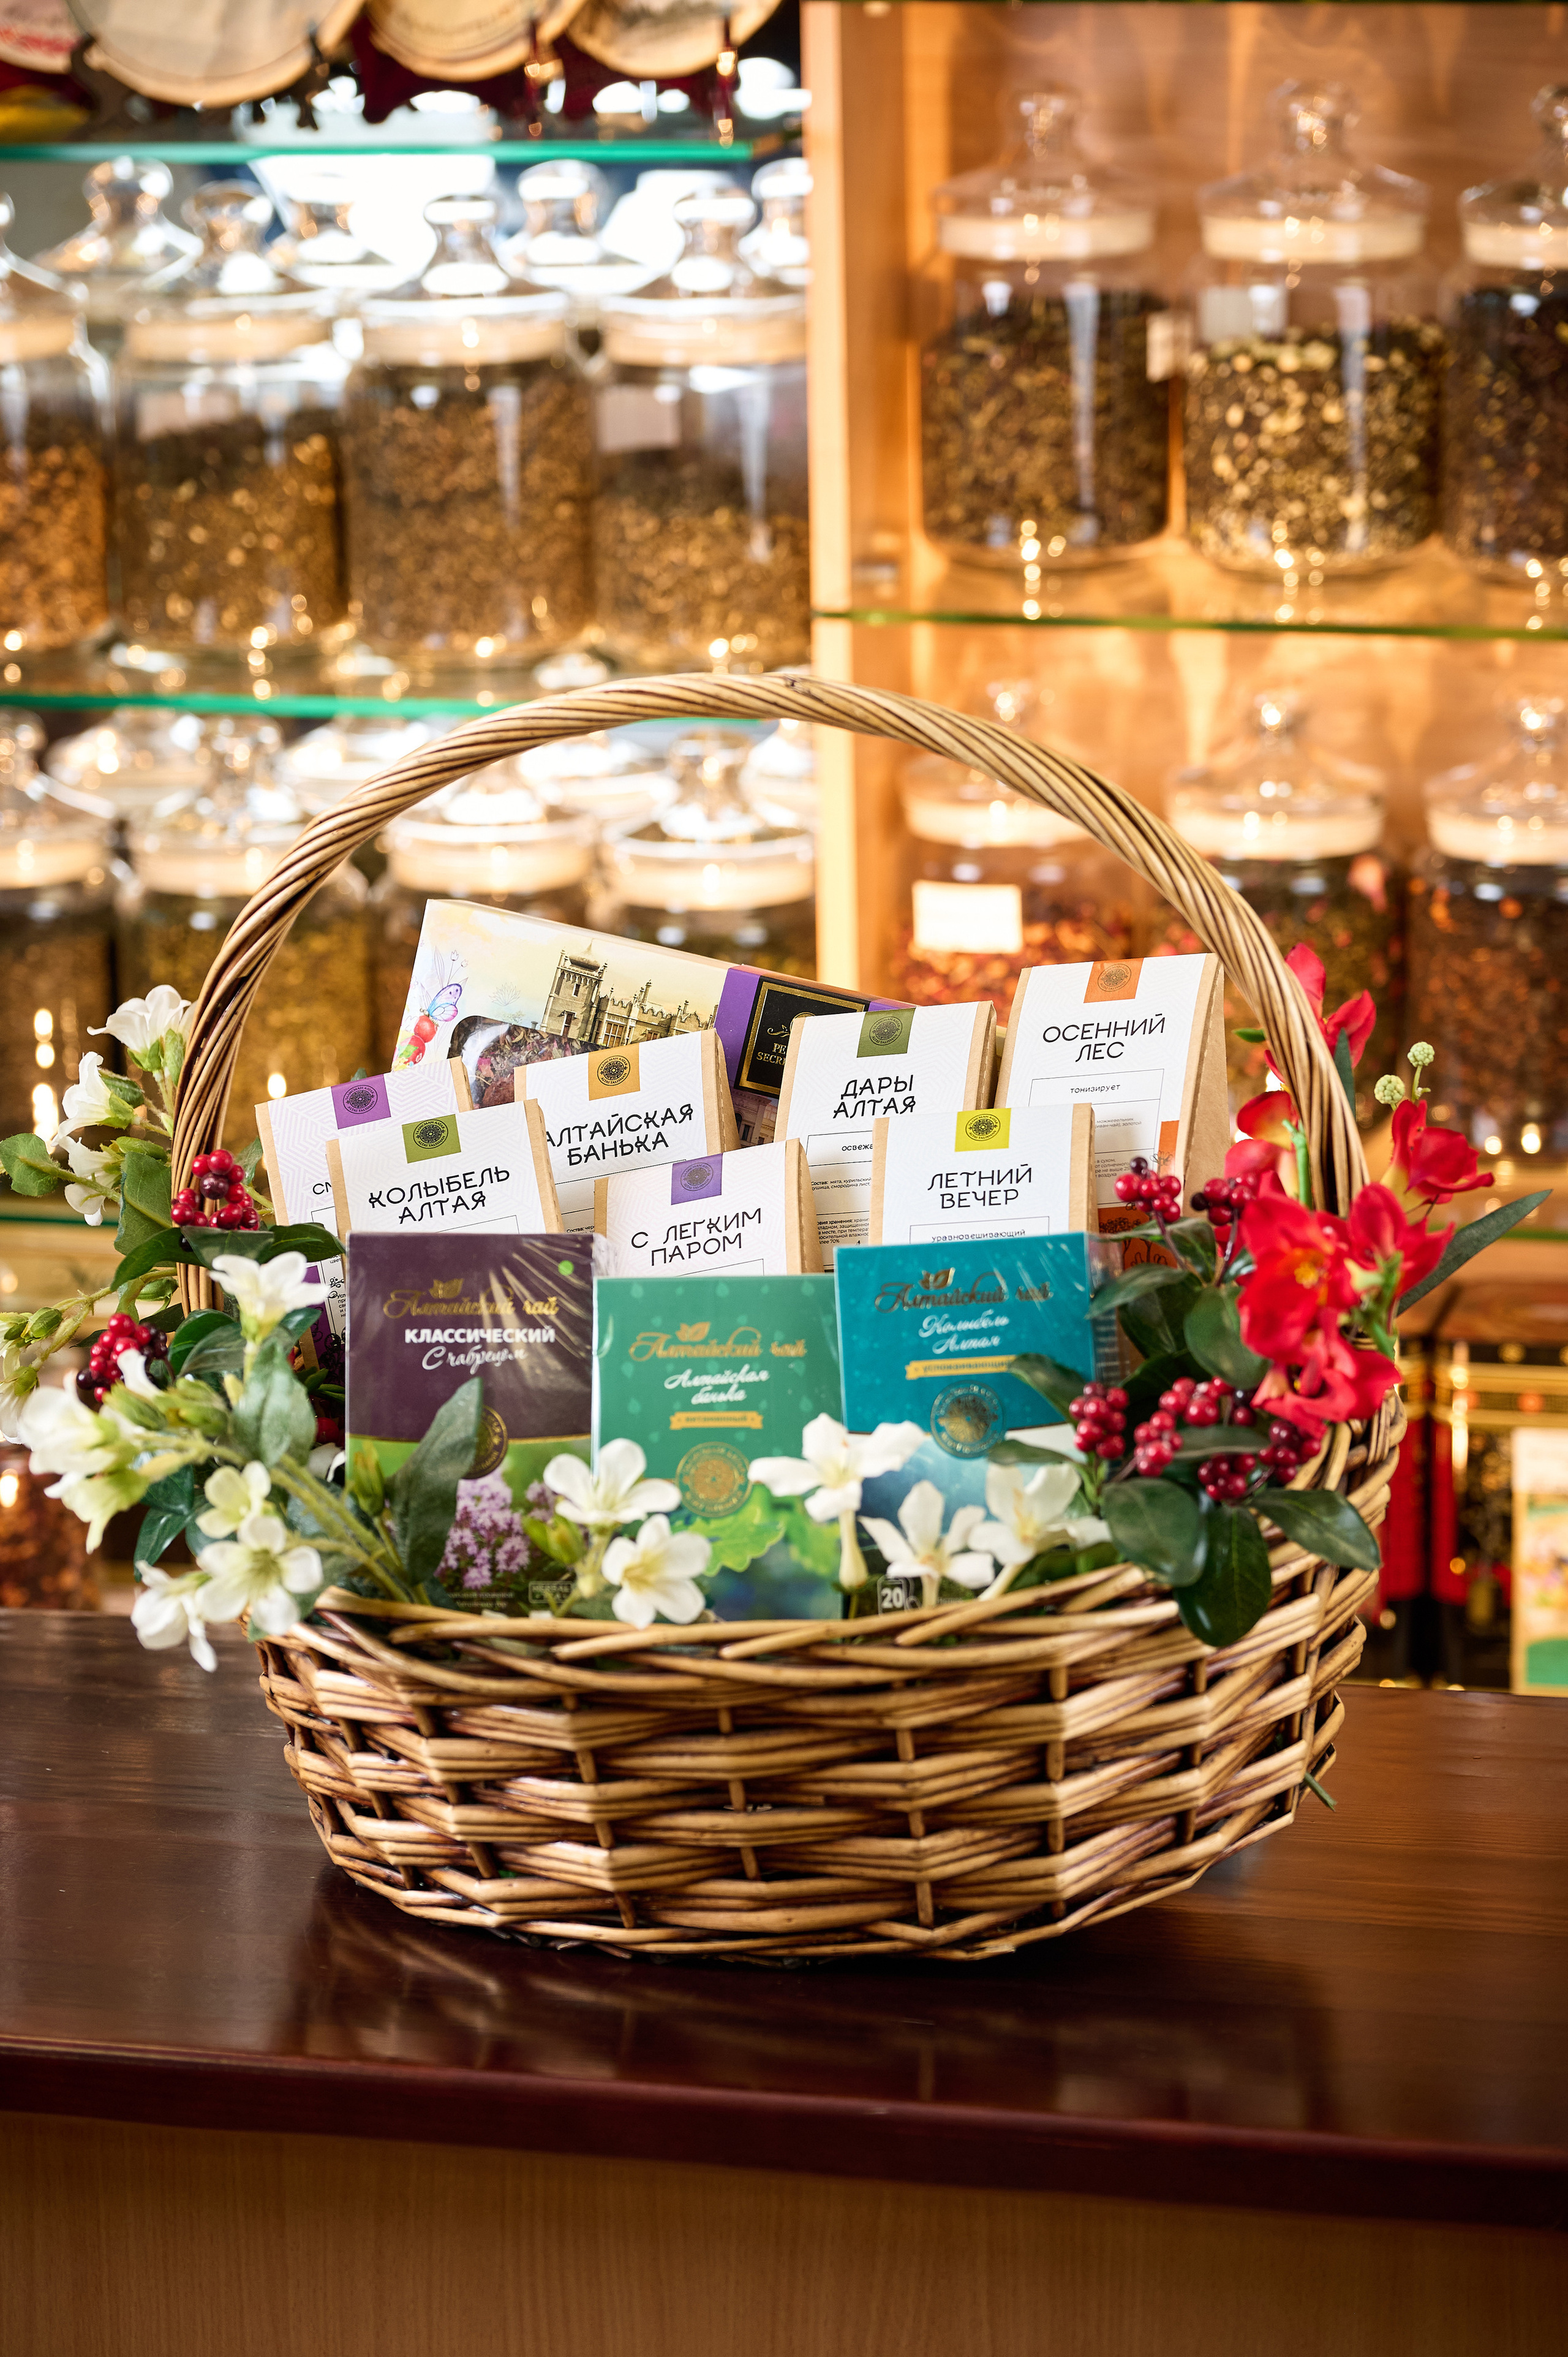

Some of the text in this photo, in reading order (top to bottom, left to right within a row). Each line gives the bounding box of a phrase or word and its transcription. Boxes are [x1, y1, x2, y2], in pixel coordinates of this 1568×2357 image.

[1042, 1013, 1166, 1043] ОСЕННИЙ
[1075, 1041, 1125, 1062] ЛЕС
[840, 1075, 913, 1100] ДАРЫ
[1070, 1083, 1121, 1094] тонизирует
[832, 1095, 916, 1119] АЛТАЯ
[567, 1132, 669, 1166] БАНЬКА
[368, 1166, 510, 1209] КОЛЫБЕЛЬ
[927, 1163, 1031, 1190] ЛЕТНИЙ
[398, 1191, 486, 1224] АЛТАЯ
[940, 1189, 1019, 1209] ВЕЧЕР
[631, 1208, 761, 1249] С ЛЕГКИМ
[932, 1229, 1025, 1243] уравновешивающий
[651, 1233, 742, 1266] ПАРОМ
[404, 1325, 556, 1344] КЛАССИЧЕСКИЙ
[918, 1309, 1010, 1338] Колыбель
[628, 1326, 763, 1362] Алтайский
[932, 1333, 1001, 1355] Алтая
[664, 1363, 771, 1390] Алтайская
[880, 1586, 904, 1609] 20
